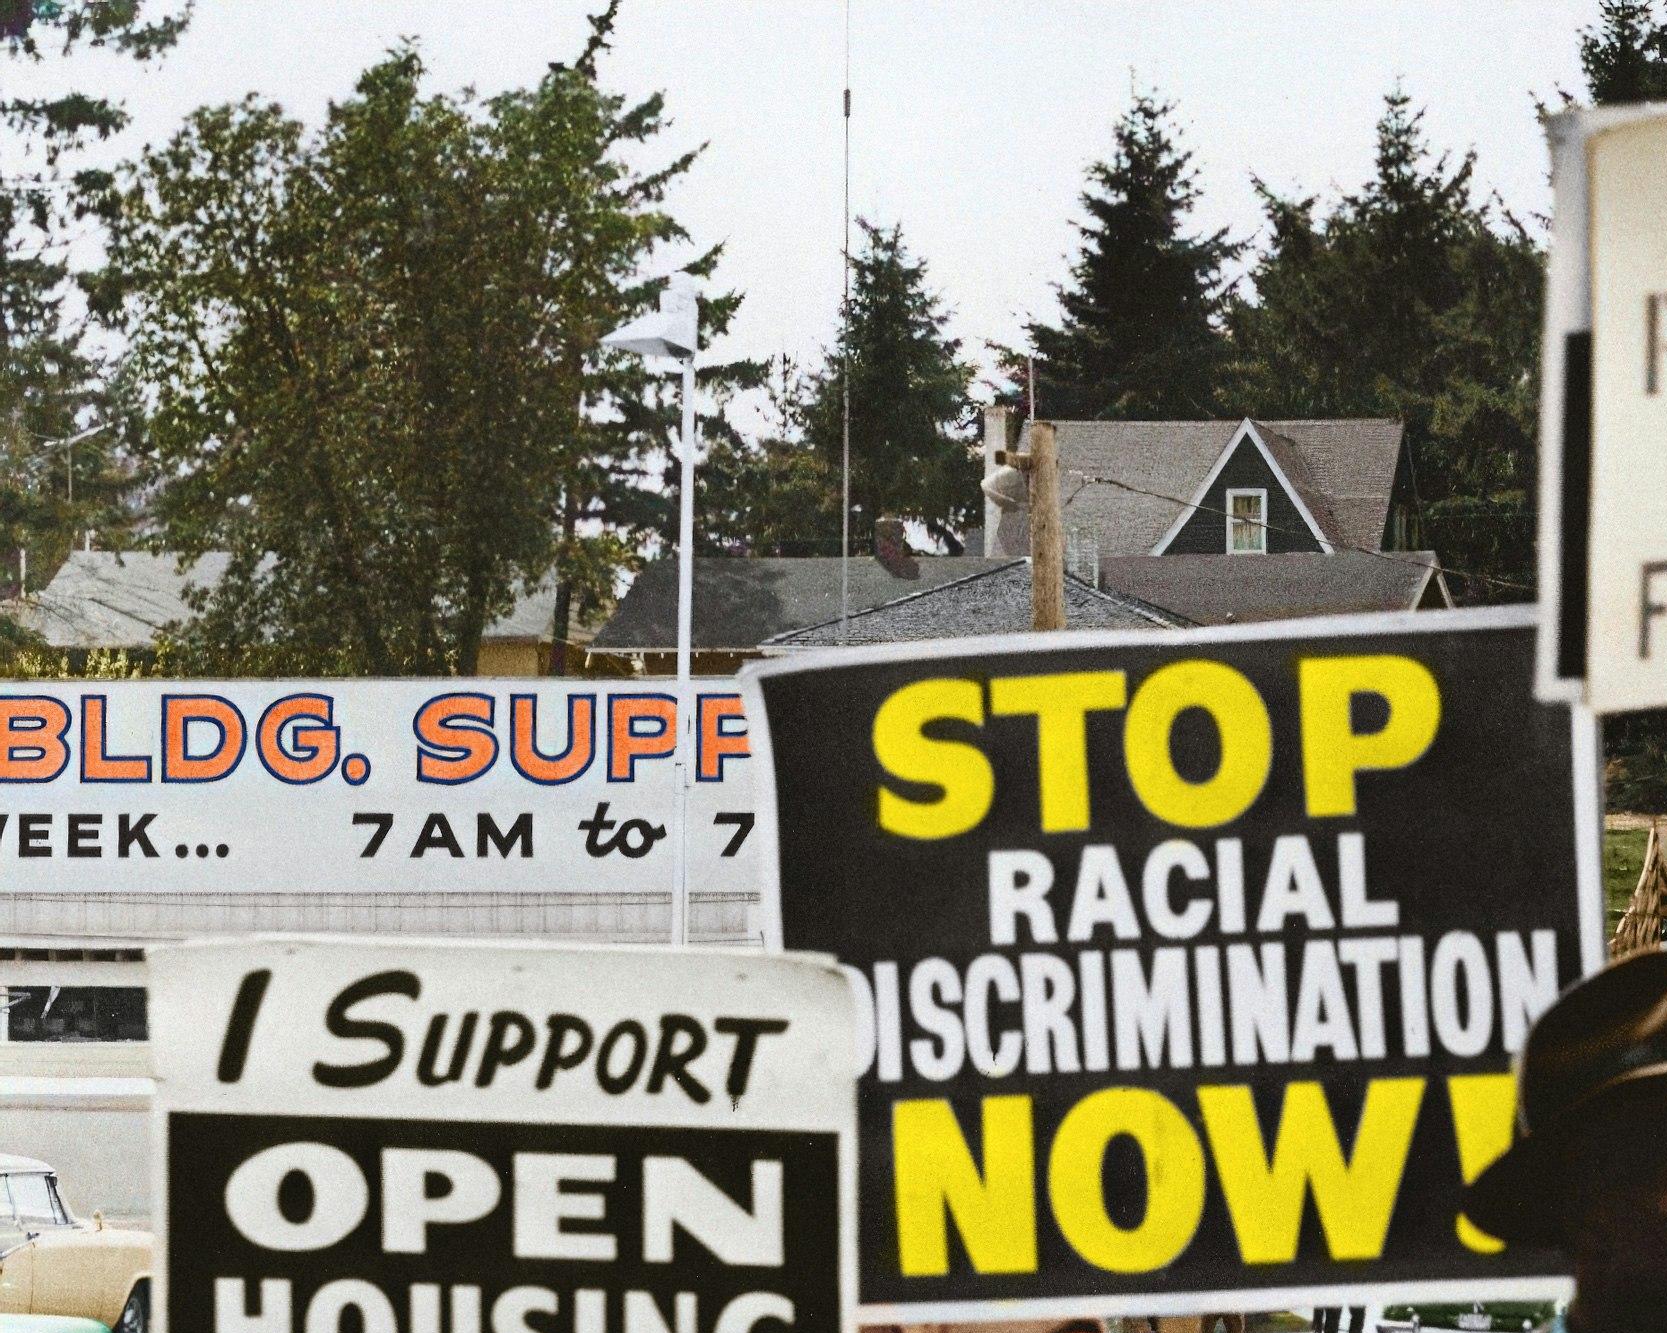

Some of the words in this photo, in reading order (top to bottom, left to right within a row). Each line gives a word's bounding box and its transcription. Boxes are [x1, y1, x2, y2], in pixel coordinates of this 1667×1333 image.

[0, 693, 371, 786] BLDG.
[870, 654, 1442, 840] STOP
[0, 812, 230, 858] EEK...
[578, 802, 667, 859] to
[714, 812, 755, 858] 7
[987, 832, 1397, 946] RACIAL
[217, 968, 272, 1084] I
[225, 1140, 785, 1268] OPEN
